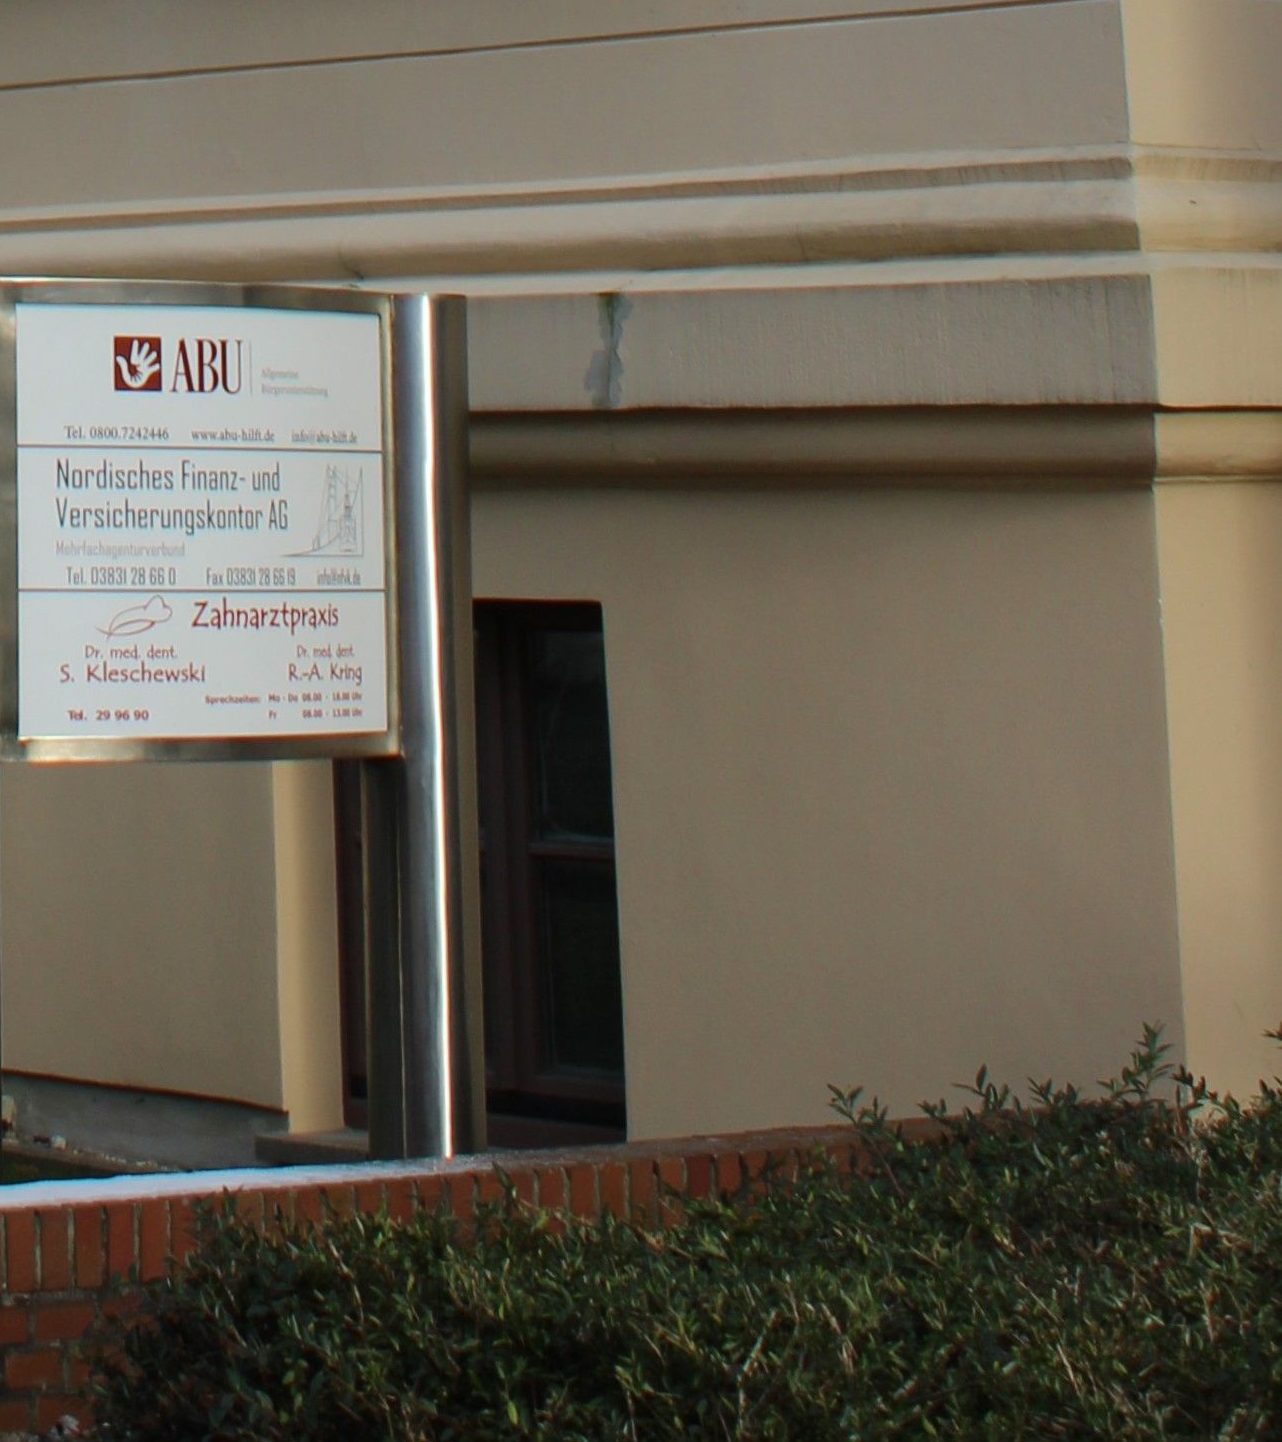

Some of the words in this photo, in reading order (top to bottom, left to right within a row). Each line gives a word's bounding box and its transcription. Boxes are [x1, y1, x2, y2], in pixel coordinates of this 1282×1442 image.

[170, 338, 242, 395] ABU
[64, 426, 85, 441] Tel.
[191, 428, 275, 443] www.abu-hilft.de
[57, 459, 173, 490] Nordisches
[182, 460, 245, 491] Finanz-
[252, 462, 280, 492] und
[56, 498, 263, 536] Versicherungskontor
[269, 499, 288, 530] AG
[67, 566, 87, 585] Tel.
[91, 566, 127, 585] 03831
[131, 567, 146, 586] 28
[149, 567, 165, 585] 66
[168, 567, 176, 586] 0
[206, 567, 223, 586] Fax
[226, 567, 256, 586] 03831
[259, 567, 270, 586] 28
[273, 567, 285, 586] 66
[192, 597, 338, 636] Zahnarztpraxis
[85, 645, 104, 659] Dr.
[110, 644, 142, 659] med.
[147, 644, 177, 660] dent.
[60, 664, 75, 683] S.
[87, 661, 205, 683] Kleschewski
[289, 663, 323, 681] R.-A.
[330, 663, 362, 686] Kring
[96, 710, 110, 721] 29
[115, 710, 130, 721] 96
[133, 710, 149, 721] 90
